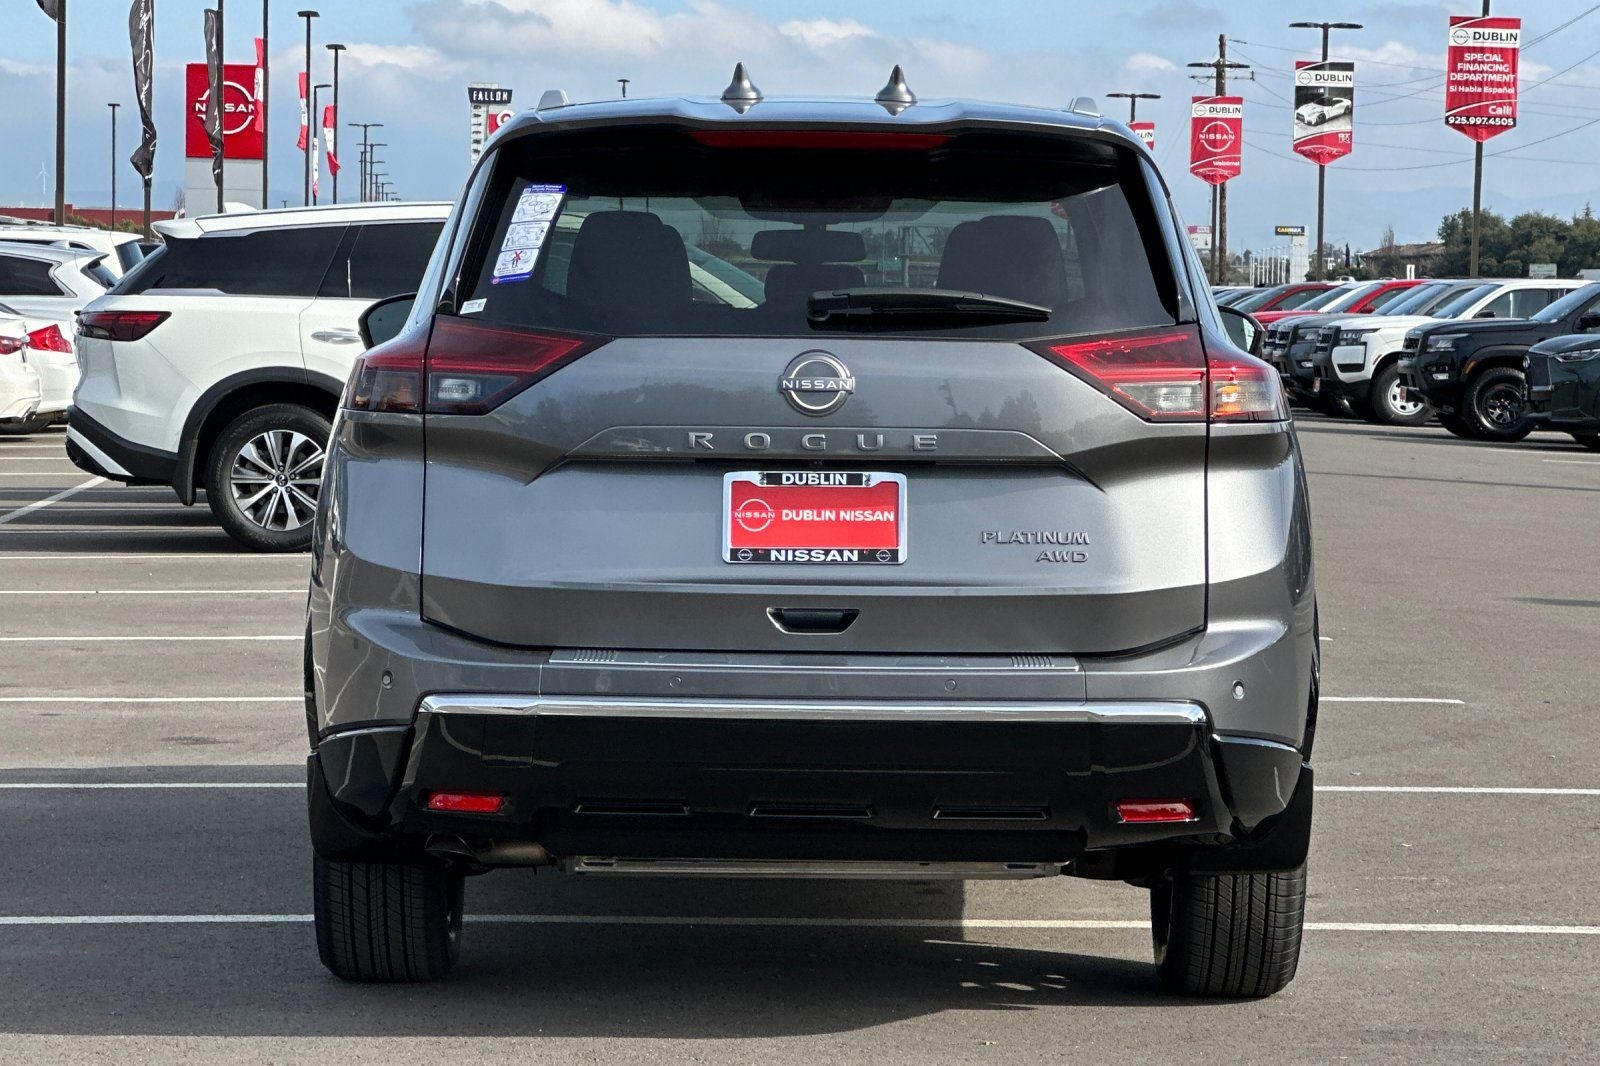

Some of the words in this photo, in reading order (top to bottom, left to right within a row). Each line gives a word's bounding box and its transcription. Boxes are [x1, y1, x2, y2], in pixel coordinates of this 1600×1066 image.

[1473, 31, 1518, 42] DUBLIN
[1464, 53, 1504, 62] SPECIAL
[1457, 63, 1510, 72] FINANCING
[1315, 73, 1352, 82] DUBLIN
[1450, 73, 1516, 82] DEPARTMENT
[1483, 86, 1515, 94] Español
[473, 90, 508, 101] FALLON
[195, 103, 255, 113] NSAN
[1488, 105, 1513, 115] Call!
[1448, 116, 1514, 126] 925.997.4505
[472, 104, 482, 156] GATEWA
[782, 379, 851, 389] NISSAN
[688, 432, 938, 450] ROGUE
[782, 473, 847, 485] DUBLIN
[734, 511, 775, 519] NISSAN
[782, 510, 836, 521] DUBLIN
[839, 510, 895, 522] NISSAN
[981, 531, 1091, 545] PLATINUM
[770, 549, 859, 562] NISSAN
[1036, 550, 1089, 563] AWD
